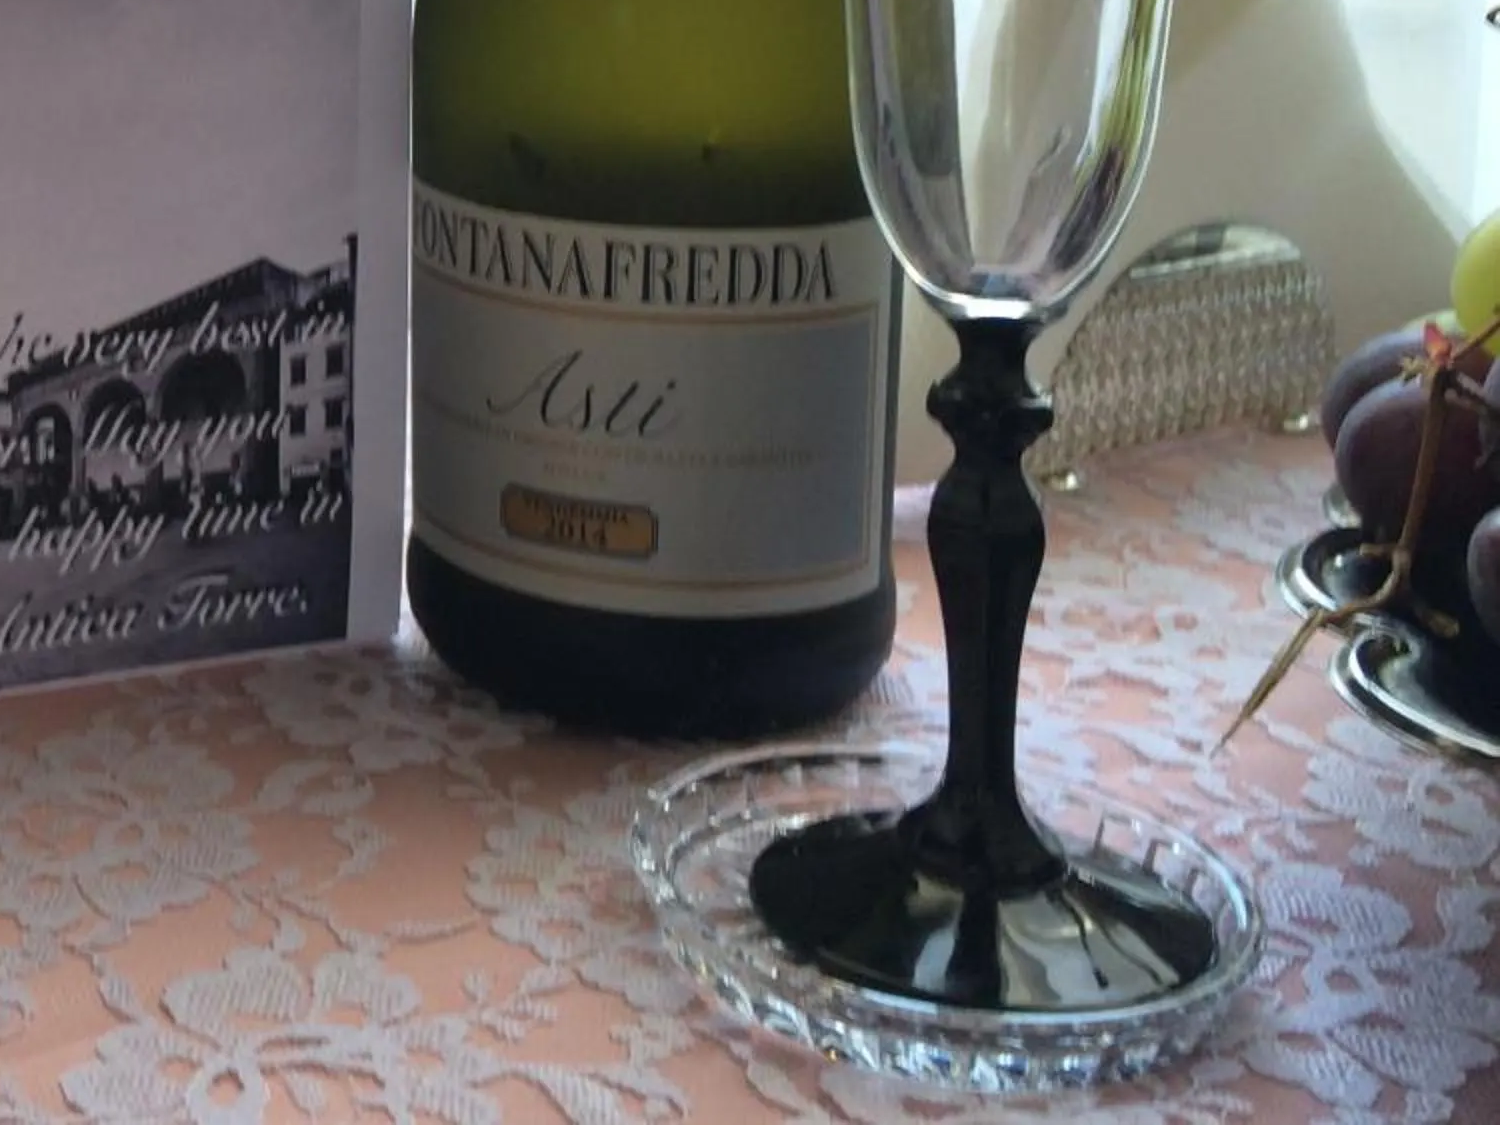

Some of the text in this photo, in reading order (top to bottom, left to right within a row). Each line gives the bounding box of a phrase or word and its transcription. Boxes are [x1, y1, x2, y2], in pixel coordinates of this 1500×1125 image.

[64, 326, 173, 371] very
[191, 301, 286, 354] best
[302, 301, 345, 342] in
[484, 349, 687, 439] Asti
[197, 411, 288, 458] you
[9, 505, 164, 574] happy
[182, 489, 285, 539] time
[300, 483, 343, 525] in
